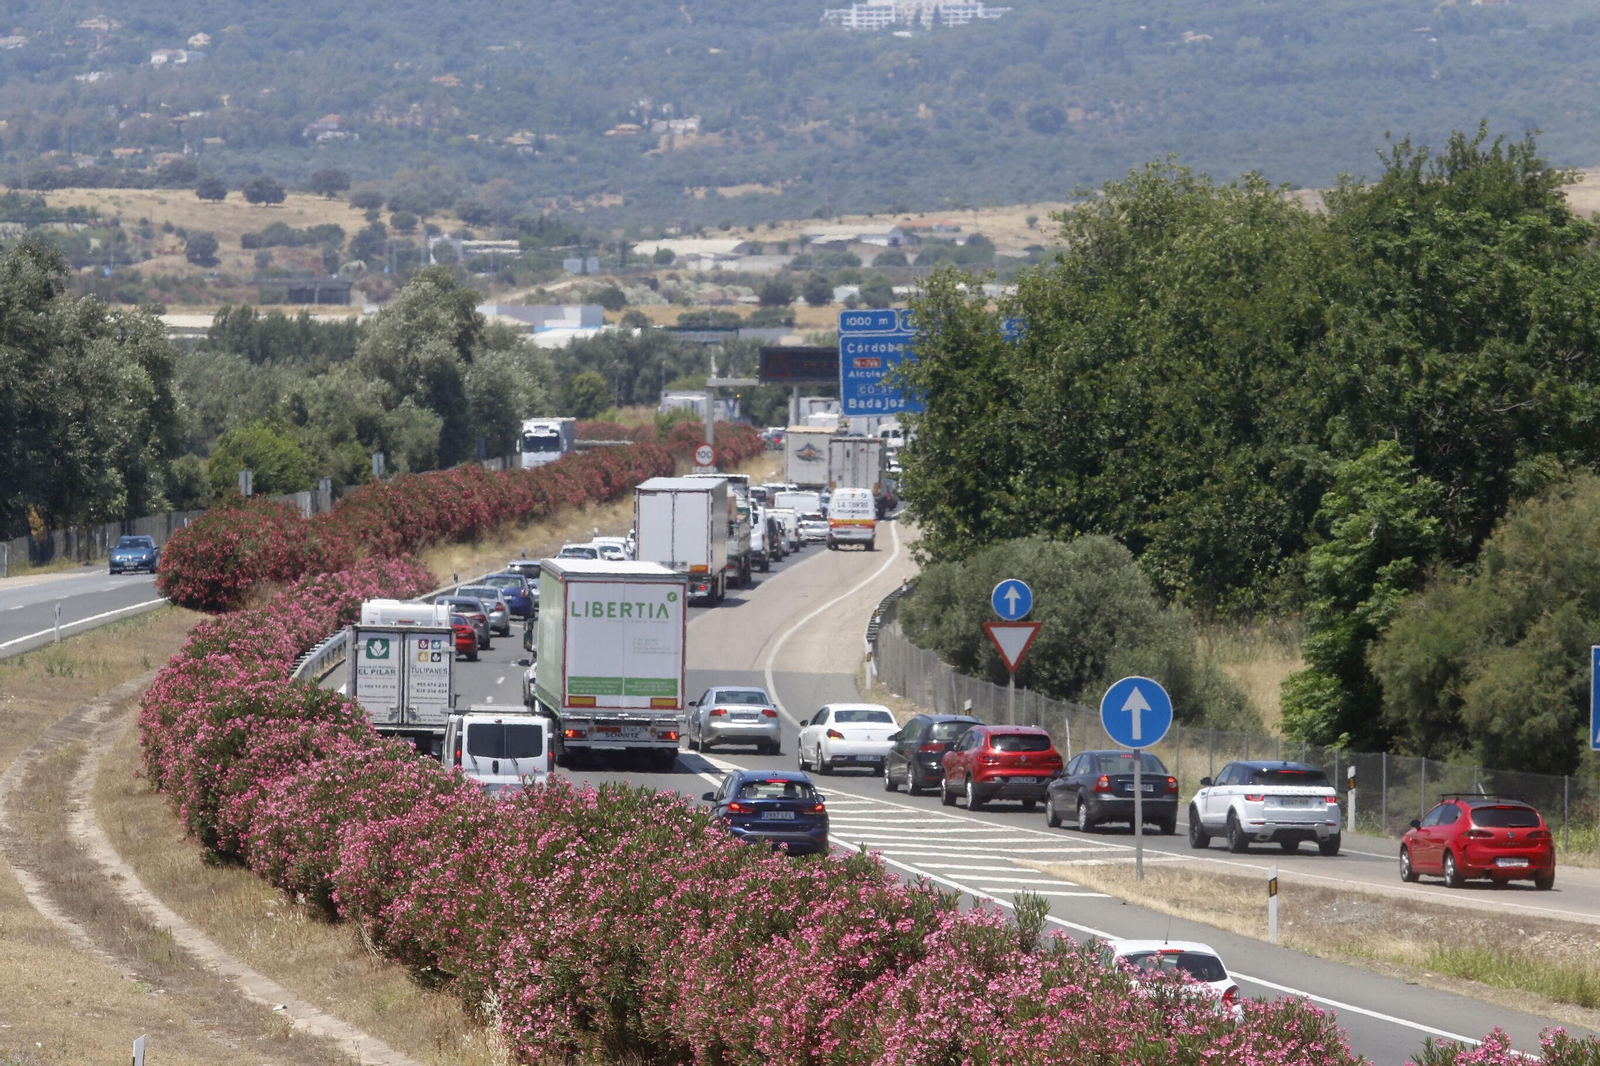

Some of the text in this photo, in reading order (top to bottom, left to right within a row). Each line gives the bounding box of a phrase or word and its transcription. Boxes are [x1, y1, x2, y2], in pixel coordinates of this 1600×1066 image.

[846, 317, 872, 326] 1000
[847, 342, 903, 353] Córdoba
[848, 397, 905, 411] Badajoz
[697, 450, 713, 459] 100
